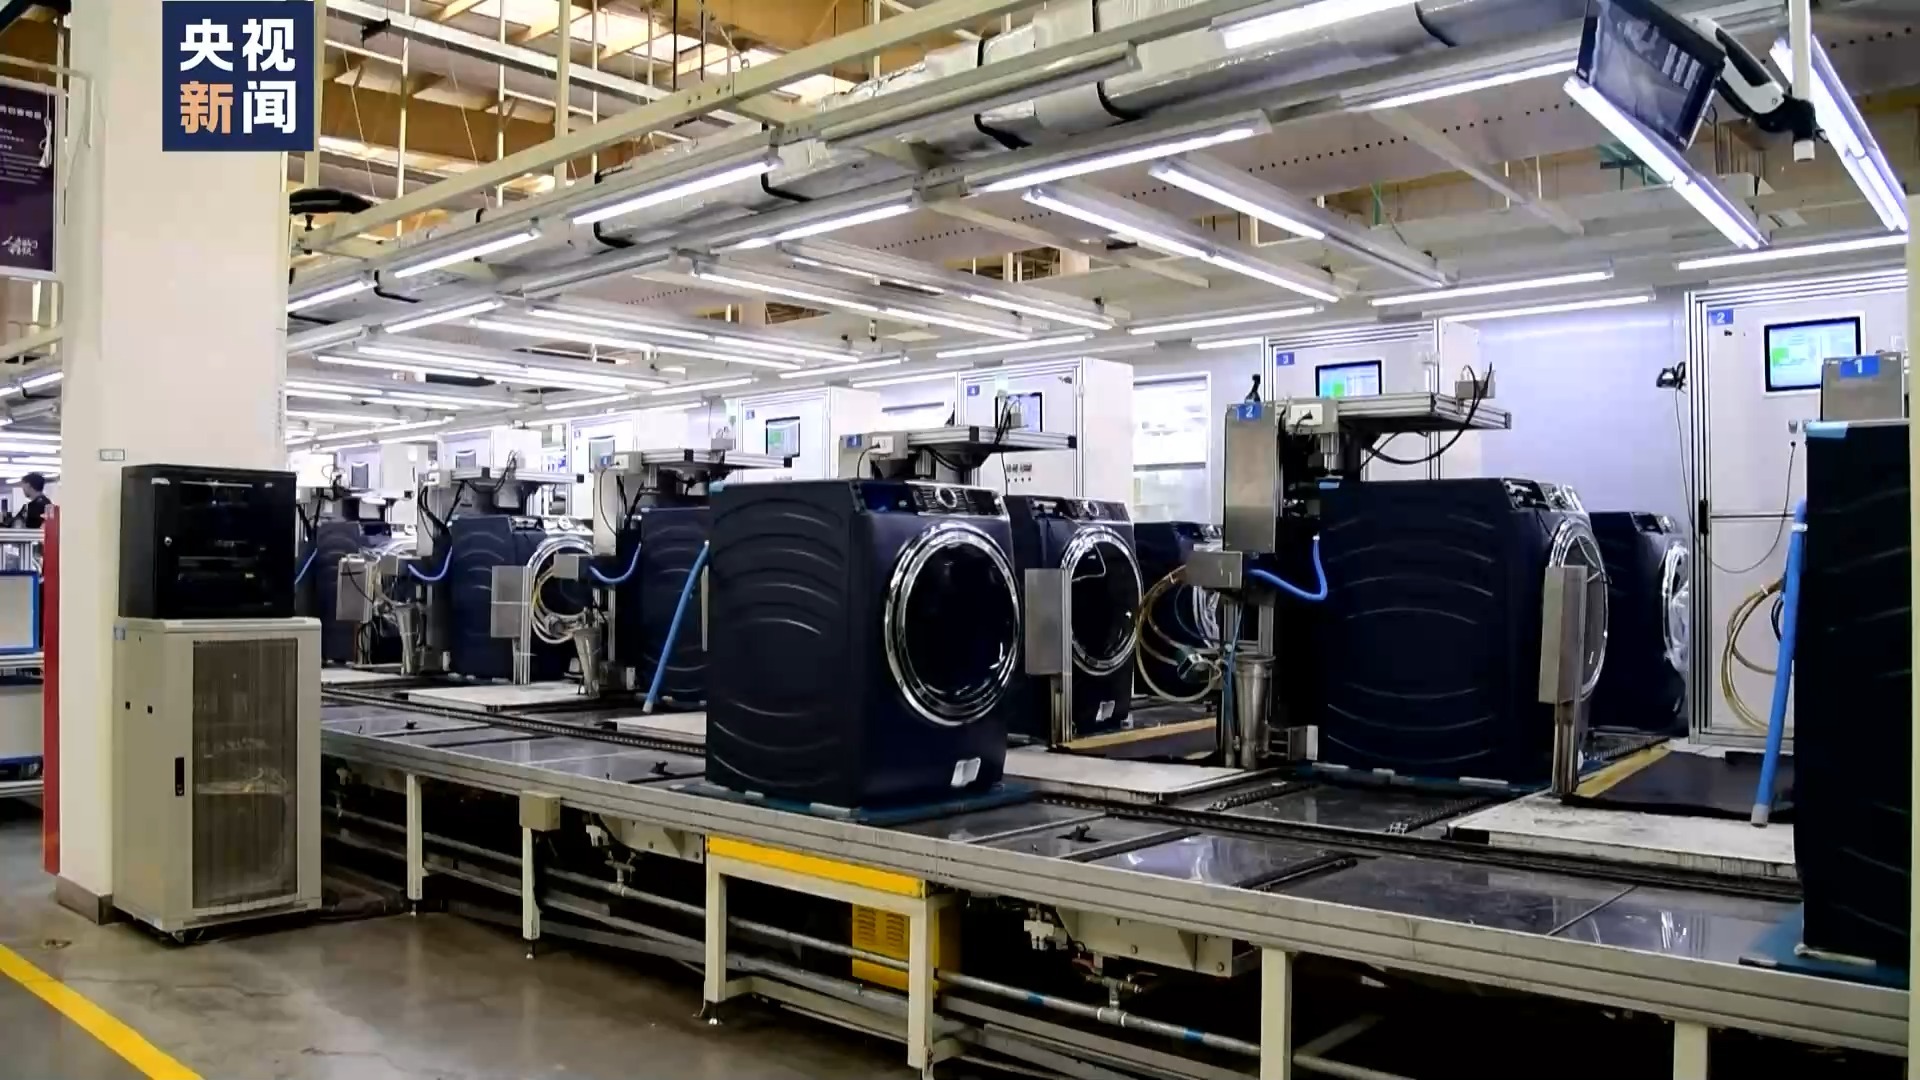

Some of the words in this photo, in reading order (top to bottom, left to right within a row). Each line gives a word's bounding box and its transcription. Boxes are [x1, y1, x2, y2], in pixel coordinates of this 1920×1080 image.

[1716, 312, 1725, 323] 2
[1854, 359, 1863, 374] 1
[1245, 405, 1253, 418] 2
